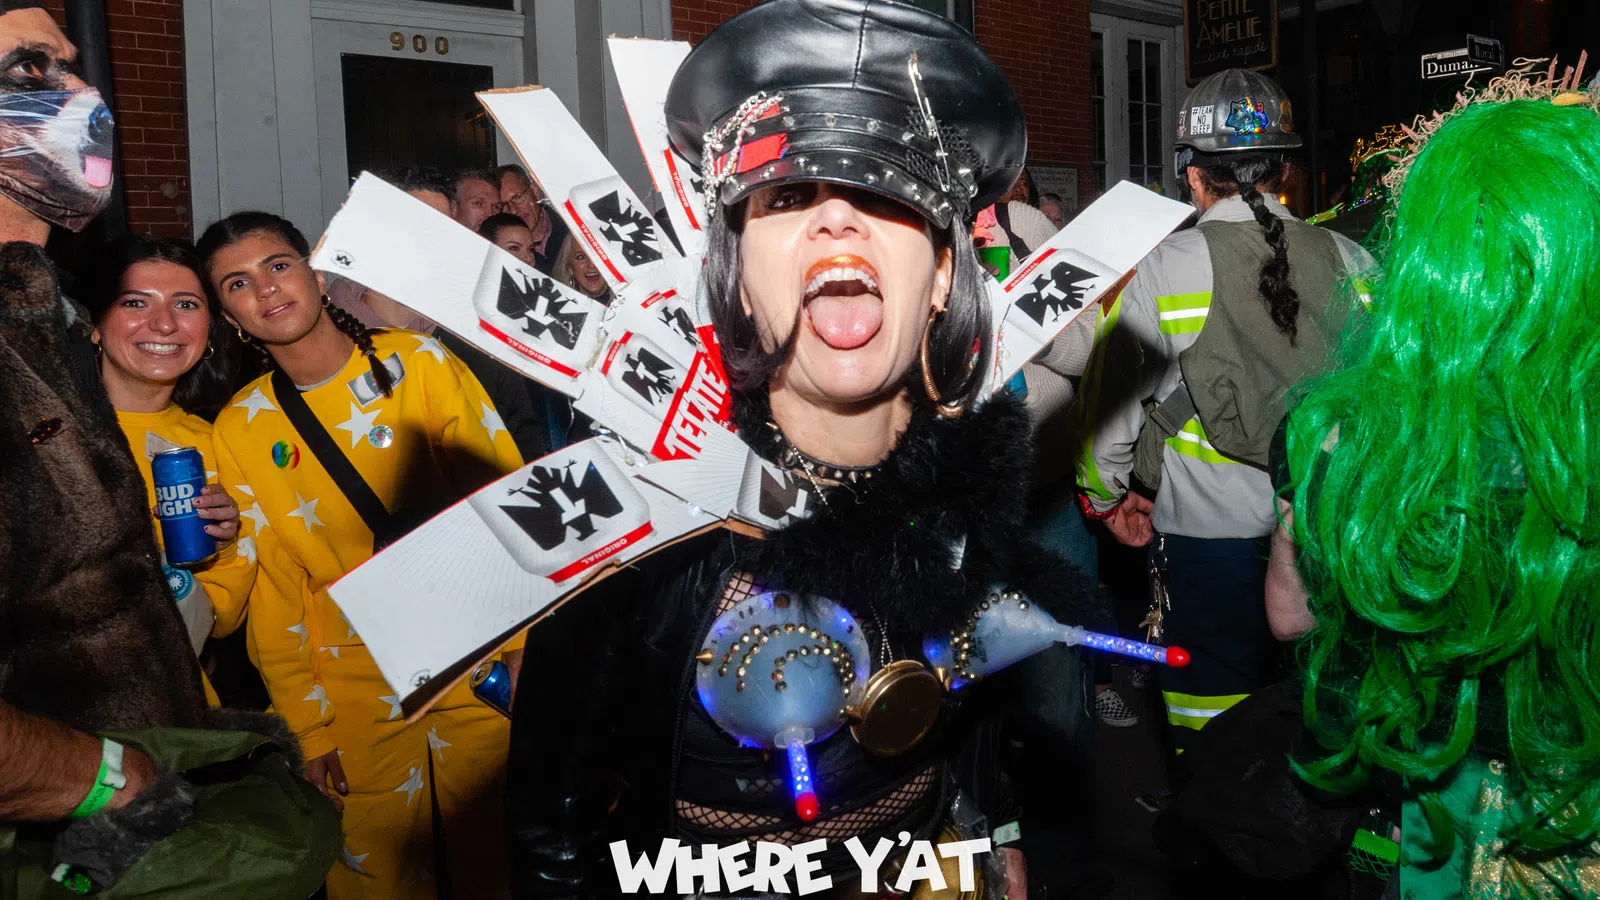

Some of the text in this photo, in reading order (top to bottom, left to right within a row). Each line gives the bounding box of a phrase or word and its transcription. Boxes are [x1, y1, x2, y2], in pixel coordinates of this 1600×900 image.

[389, 31, 449, 55] 900
[1474, 44, 1495, 61] Royal
[1426, 59, 1480, 75] Duma
[1192, 106, 1213, 115] #TEAM
[1197, 114, 1206, 125] NO
[1192, 124, 1211, 135] SLEEP
[673, 171, 690, 208] ORIGINAL
[580, 223, 608, 261] ORIGINAL
[1010, 261, 1039, 288] ORIGINAL
[506, 337, 552, 365] ORIGINAL
[663, 357, 728, 456] TECATE
[156, 483, 194, 501] BUD
[158, 497, 197, 517] IGH
[580, 537, 628, 565] ORIGINAL
